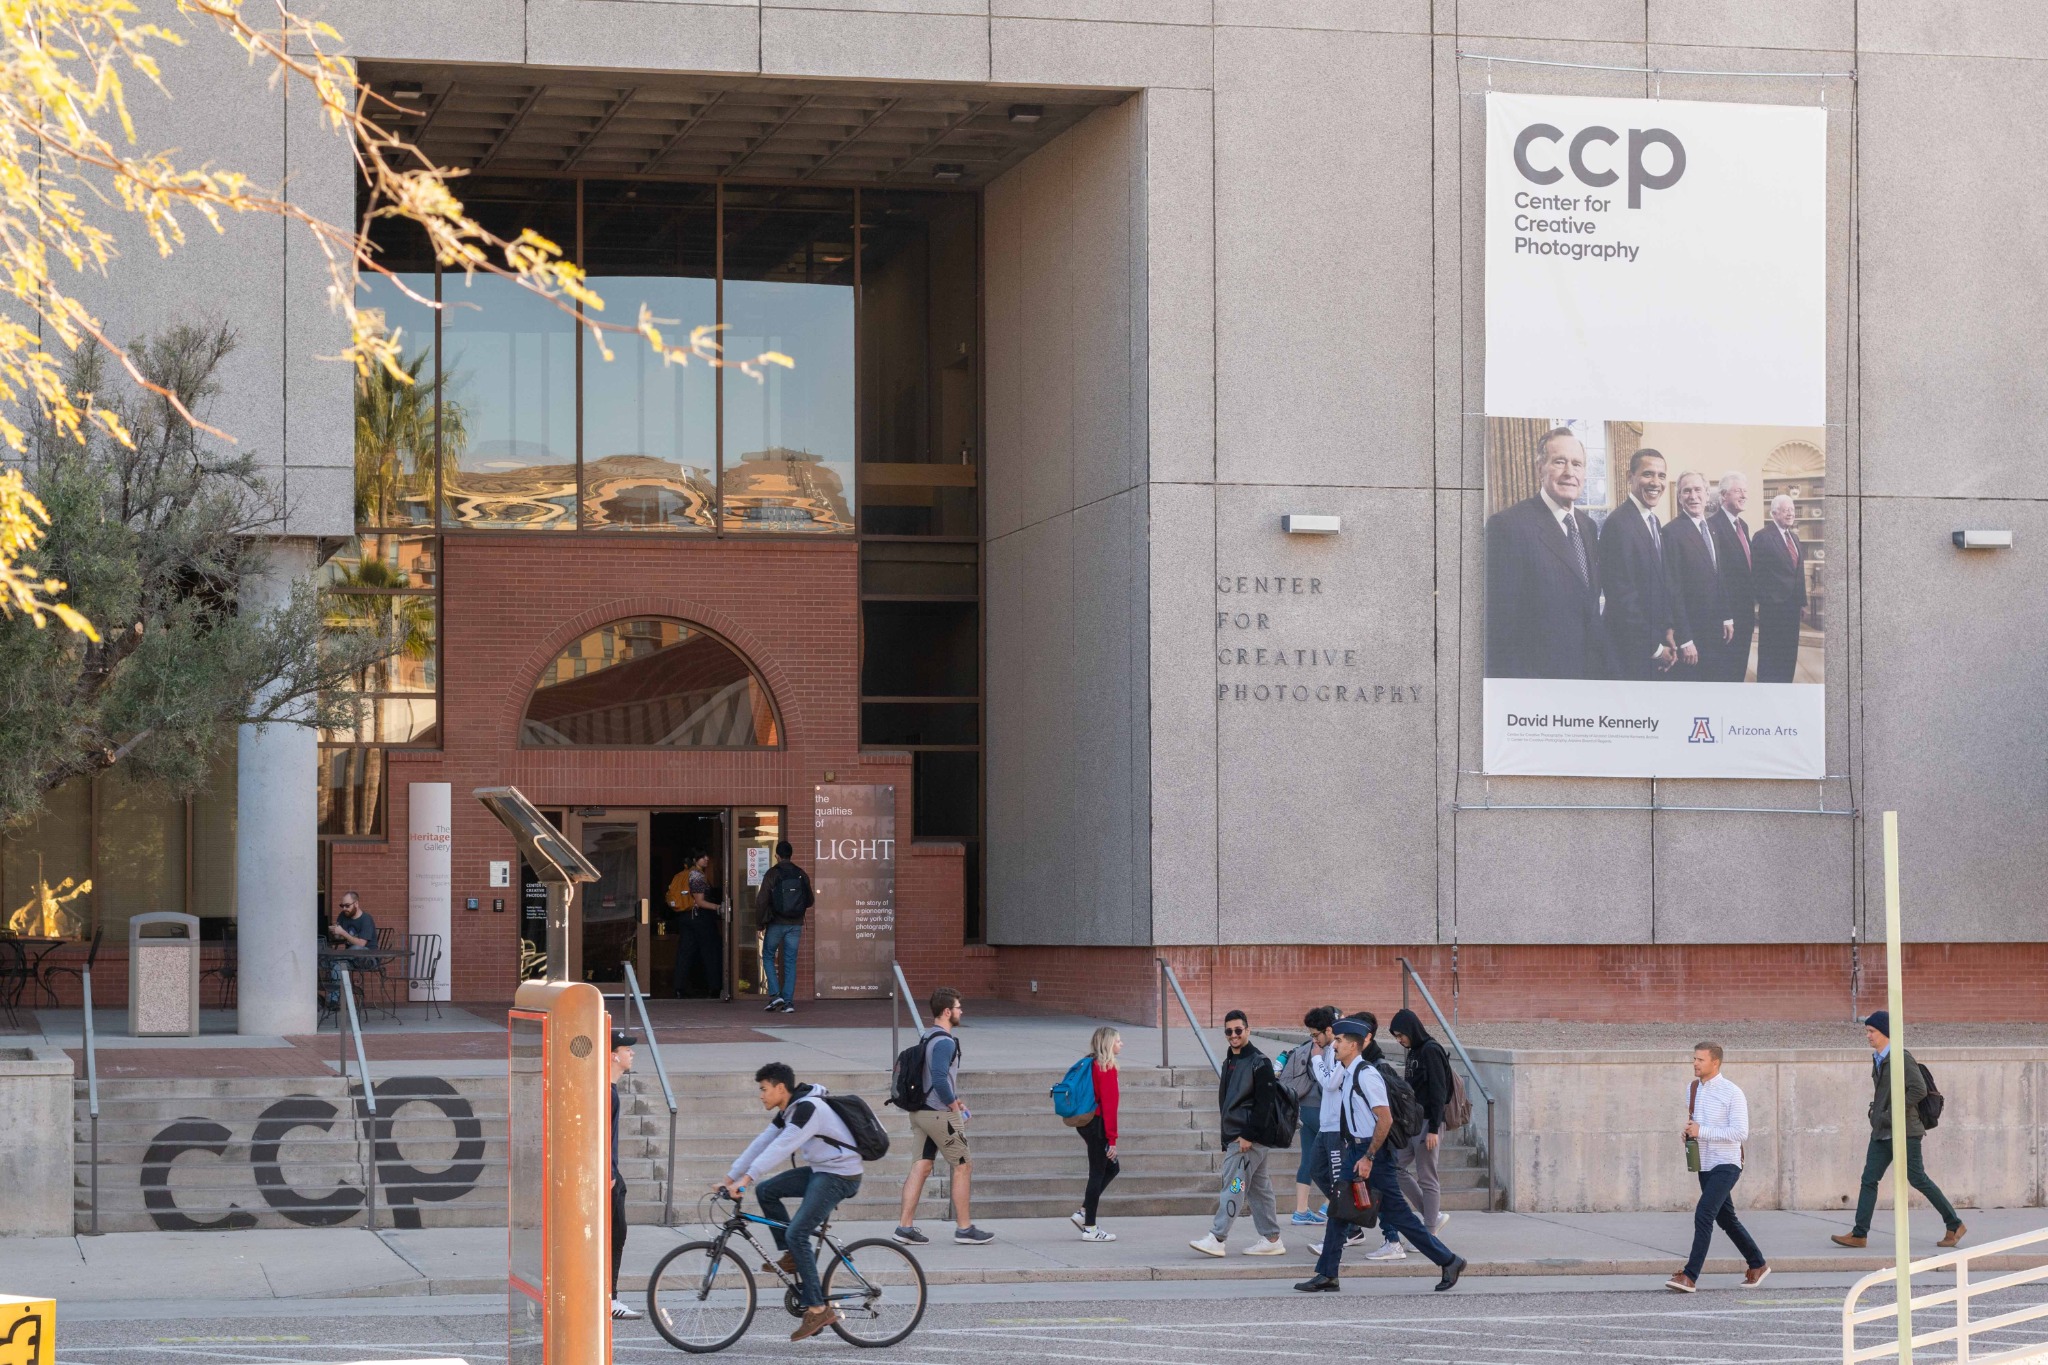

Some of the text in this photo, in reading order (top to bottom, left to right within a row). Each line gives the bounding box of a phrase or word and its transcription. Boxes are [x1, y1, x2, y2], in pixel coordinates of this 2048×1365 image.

[1513, 123, 1687, 209] ccp
[1514, 191, 1611, 212] Center for
[1514, 214, 1596, 235] Creative
[1514, 236, 1640, 263] Photography
[1218, 576, 1323, 594] CENTER
[1217, 612, 1270, 630] FOR
[1218, 648, 1356, 667] CREATIVE
[1218, 683, 1423, 703] PHOTOGRAPHY
[1507, 713, 1660, 732] David Hume Kennerly
[1728, 725, 1798, 736] Arizona Arts
[815, 794, 830, 803] the
[815, 806, 853, 817] qualities
[436, 825, 450, 833] The
[815, 819, 824, 828] of
[410, 832, 450, 843] Heritage
[424, 842, 450, 852] Gallery
[815, 838, 895, 860] LIGHT
[866, 900, 881, 908] story
[869, 915, 882, 923] york
[883, 915, 895, 923] city
[856, 923, 893, 932] photography
[855, 931, 876, 940] gallery
[140, 1076, 486, 1231] ccp
